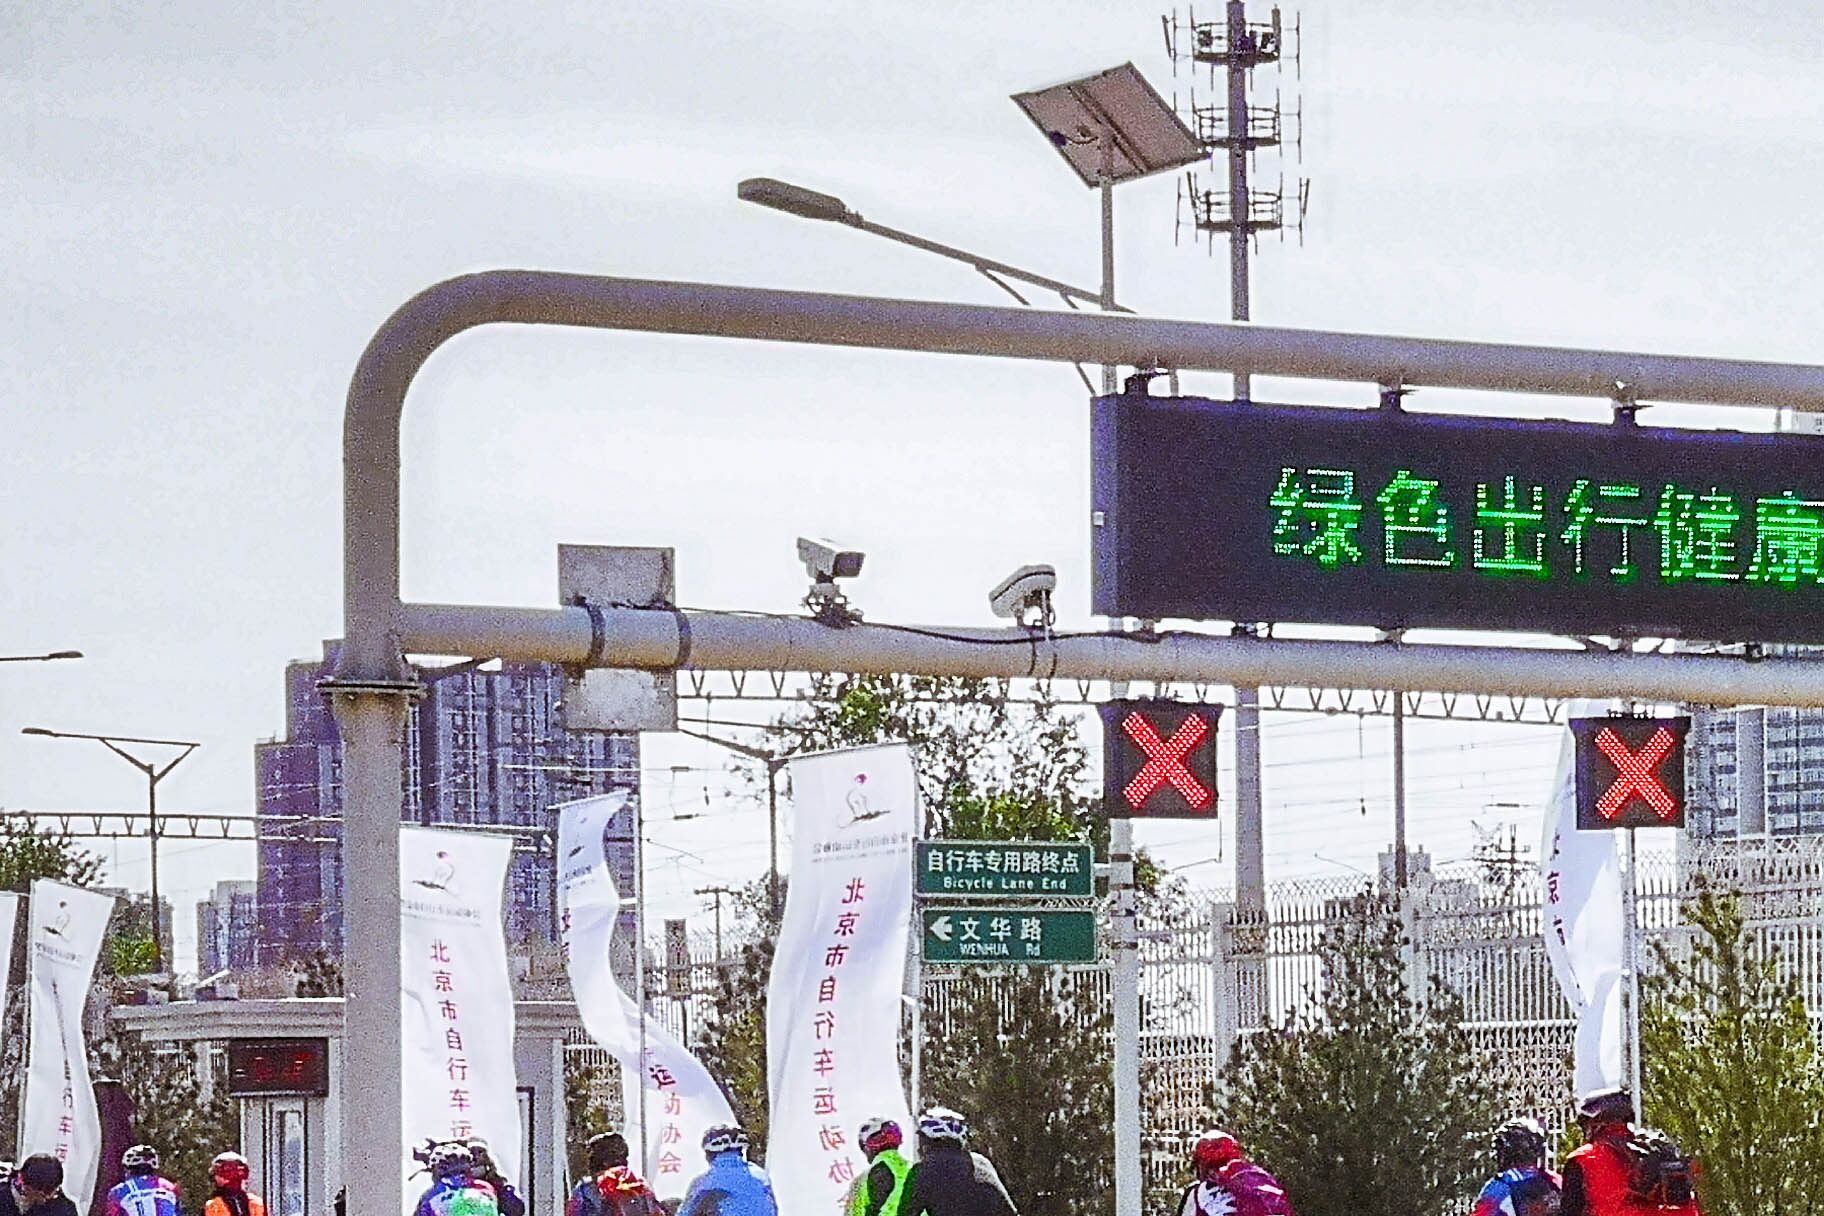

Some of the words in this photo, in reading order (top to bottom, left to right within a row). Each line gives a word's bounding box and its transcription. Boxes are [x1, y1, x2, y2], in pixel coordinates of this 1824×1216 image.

[927, 849, 1080, 874] 自行车专用路终点
[943, 876, 994, 891] Bicycle
[1001, 877, 1034, 890] Lane
[1041, 877, 1067, 890] End
[959, 916, 1042, 942] 文华路
[959, 943, 1010, 956] WENHUA
[1025, 943, 1041, 957] Rd
